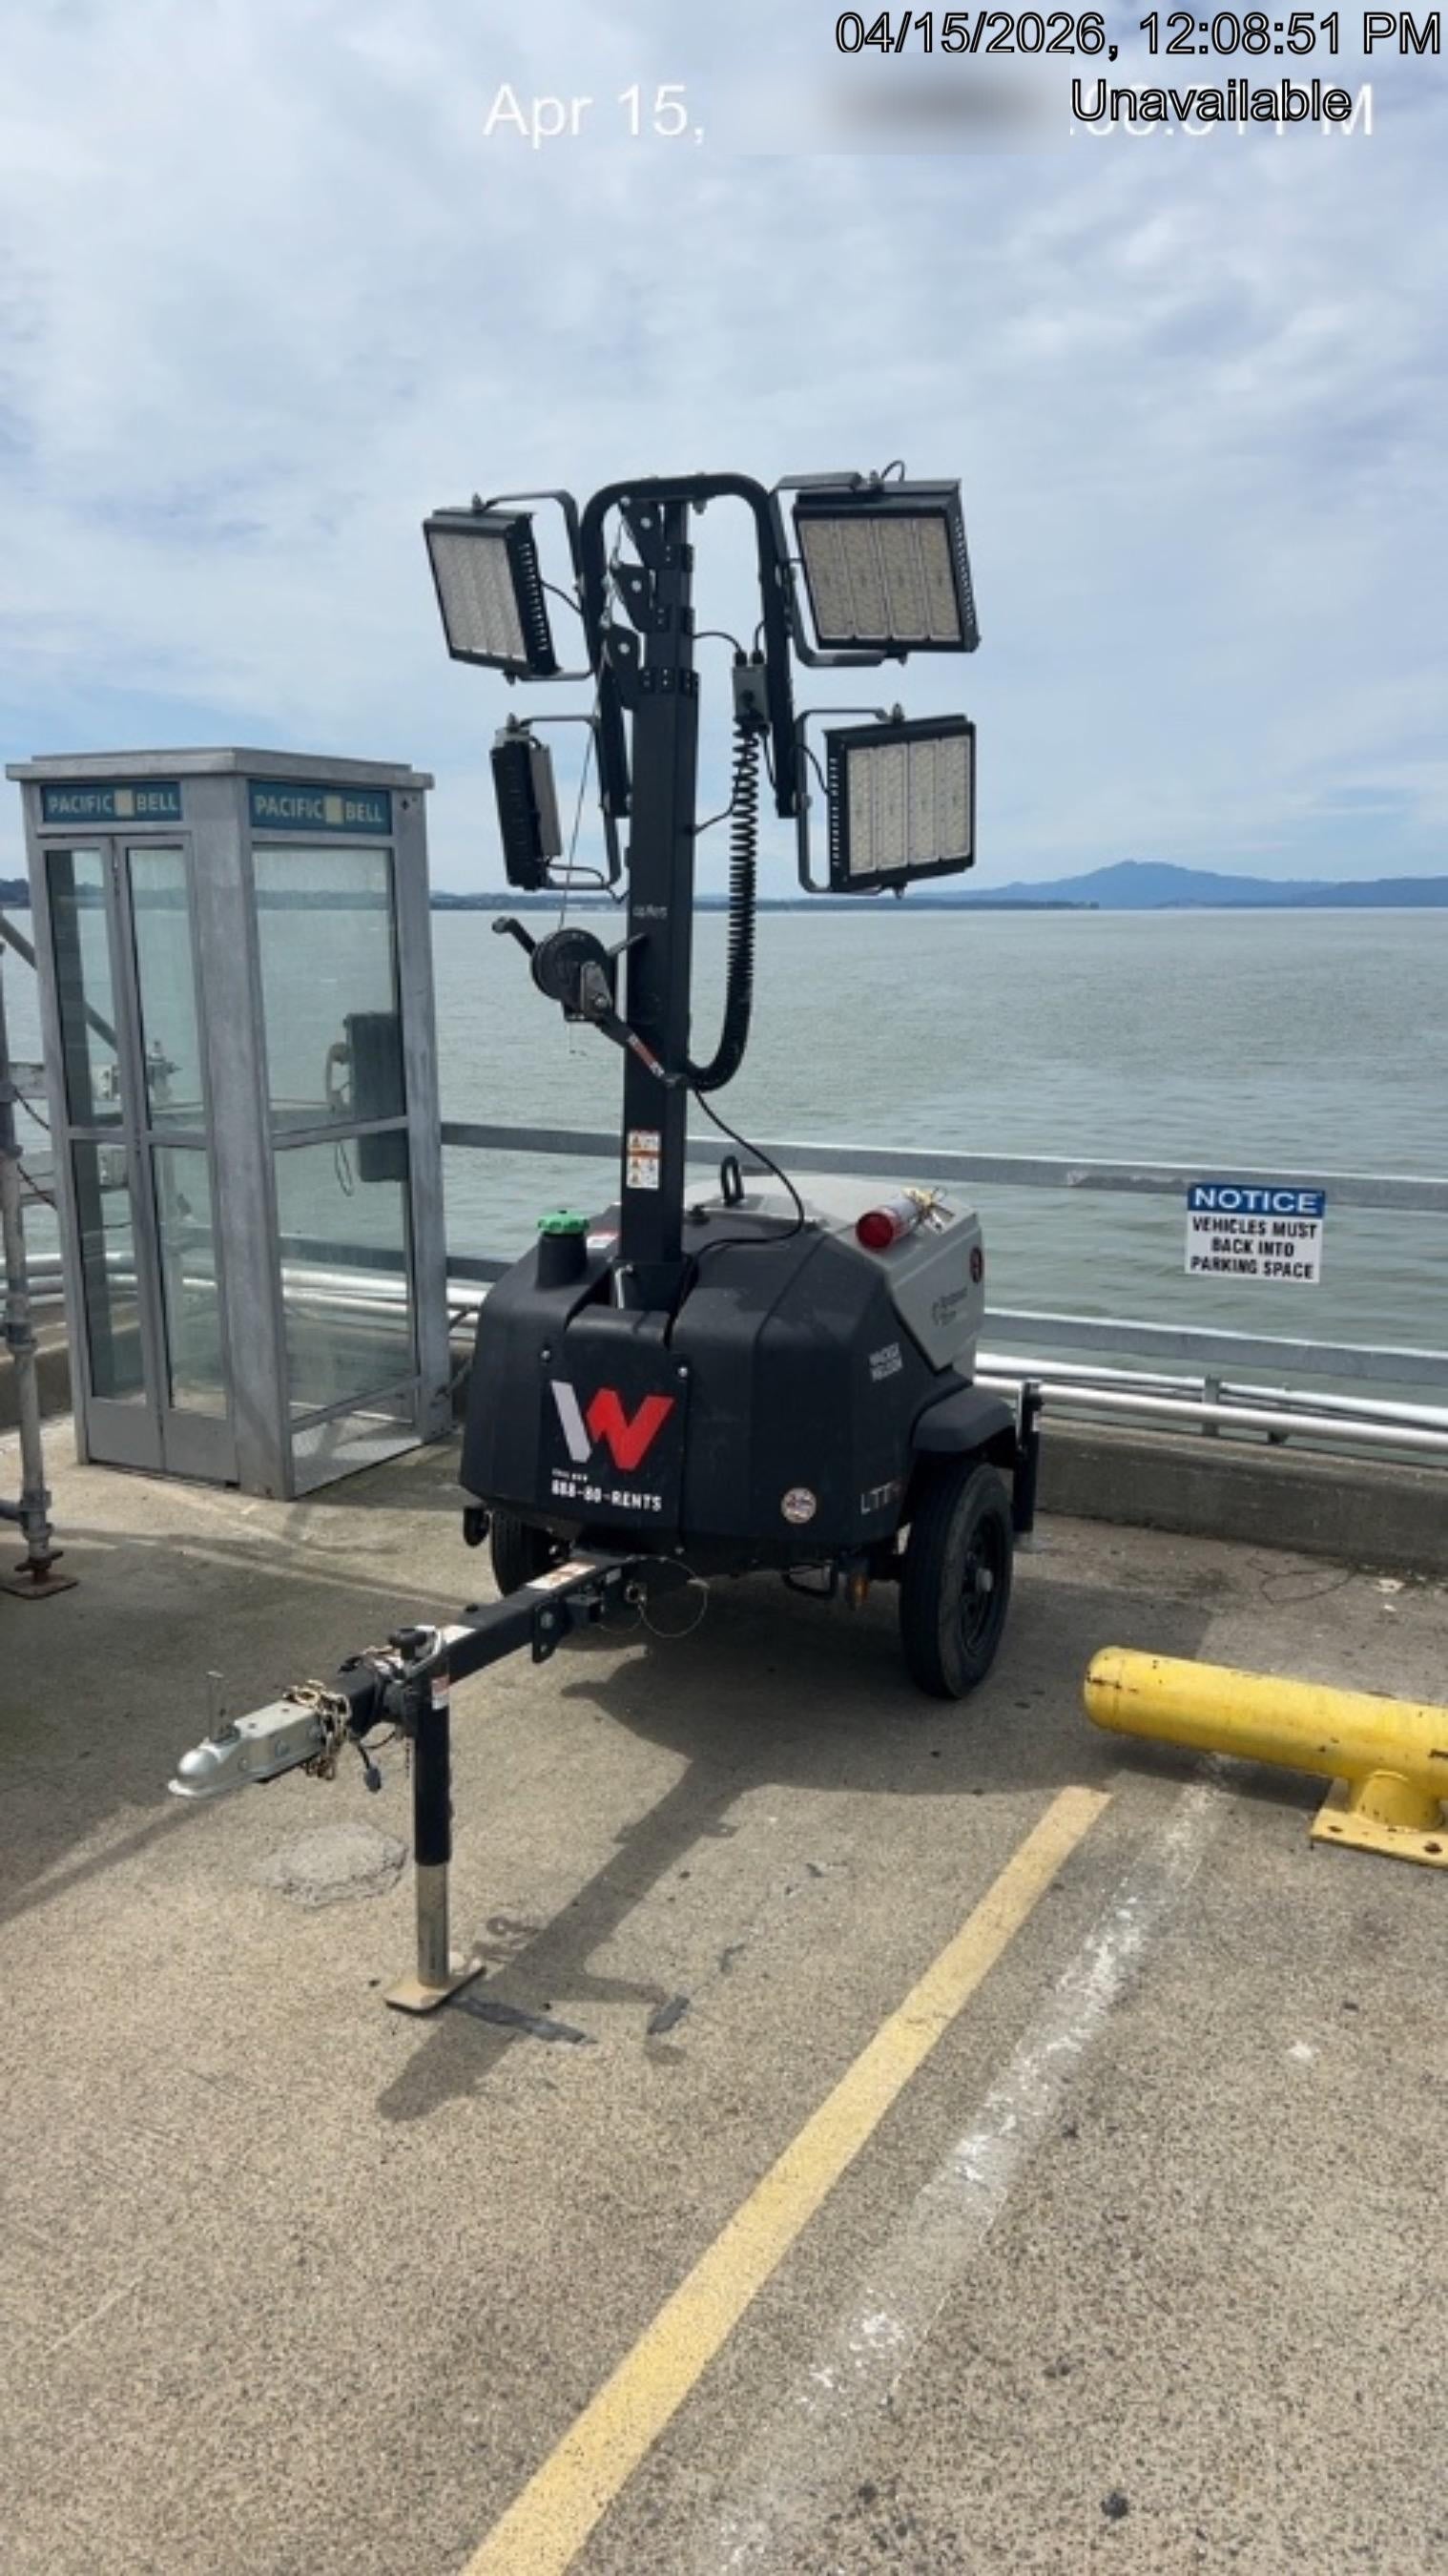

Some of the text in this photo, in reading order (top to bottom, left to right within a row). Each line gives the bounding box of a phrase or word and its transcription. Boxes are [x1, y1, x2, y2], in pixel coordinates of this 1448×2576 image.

[48, 792, 177, 815] PACIFIC BELL
[255, 795, 383, 823] PACIFIC BELL
[1194, 1187, 1319, 1214] NOTICE
[1192, 1216, 1317, 1239] VEHICLES MUST
[1211, 1236, 1294, 1257] BACK INTO
[1191, 1256, 1314, 1279] PARKING SPACE
